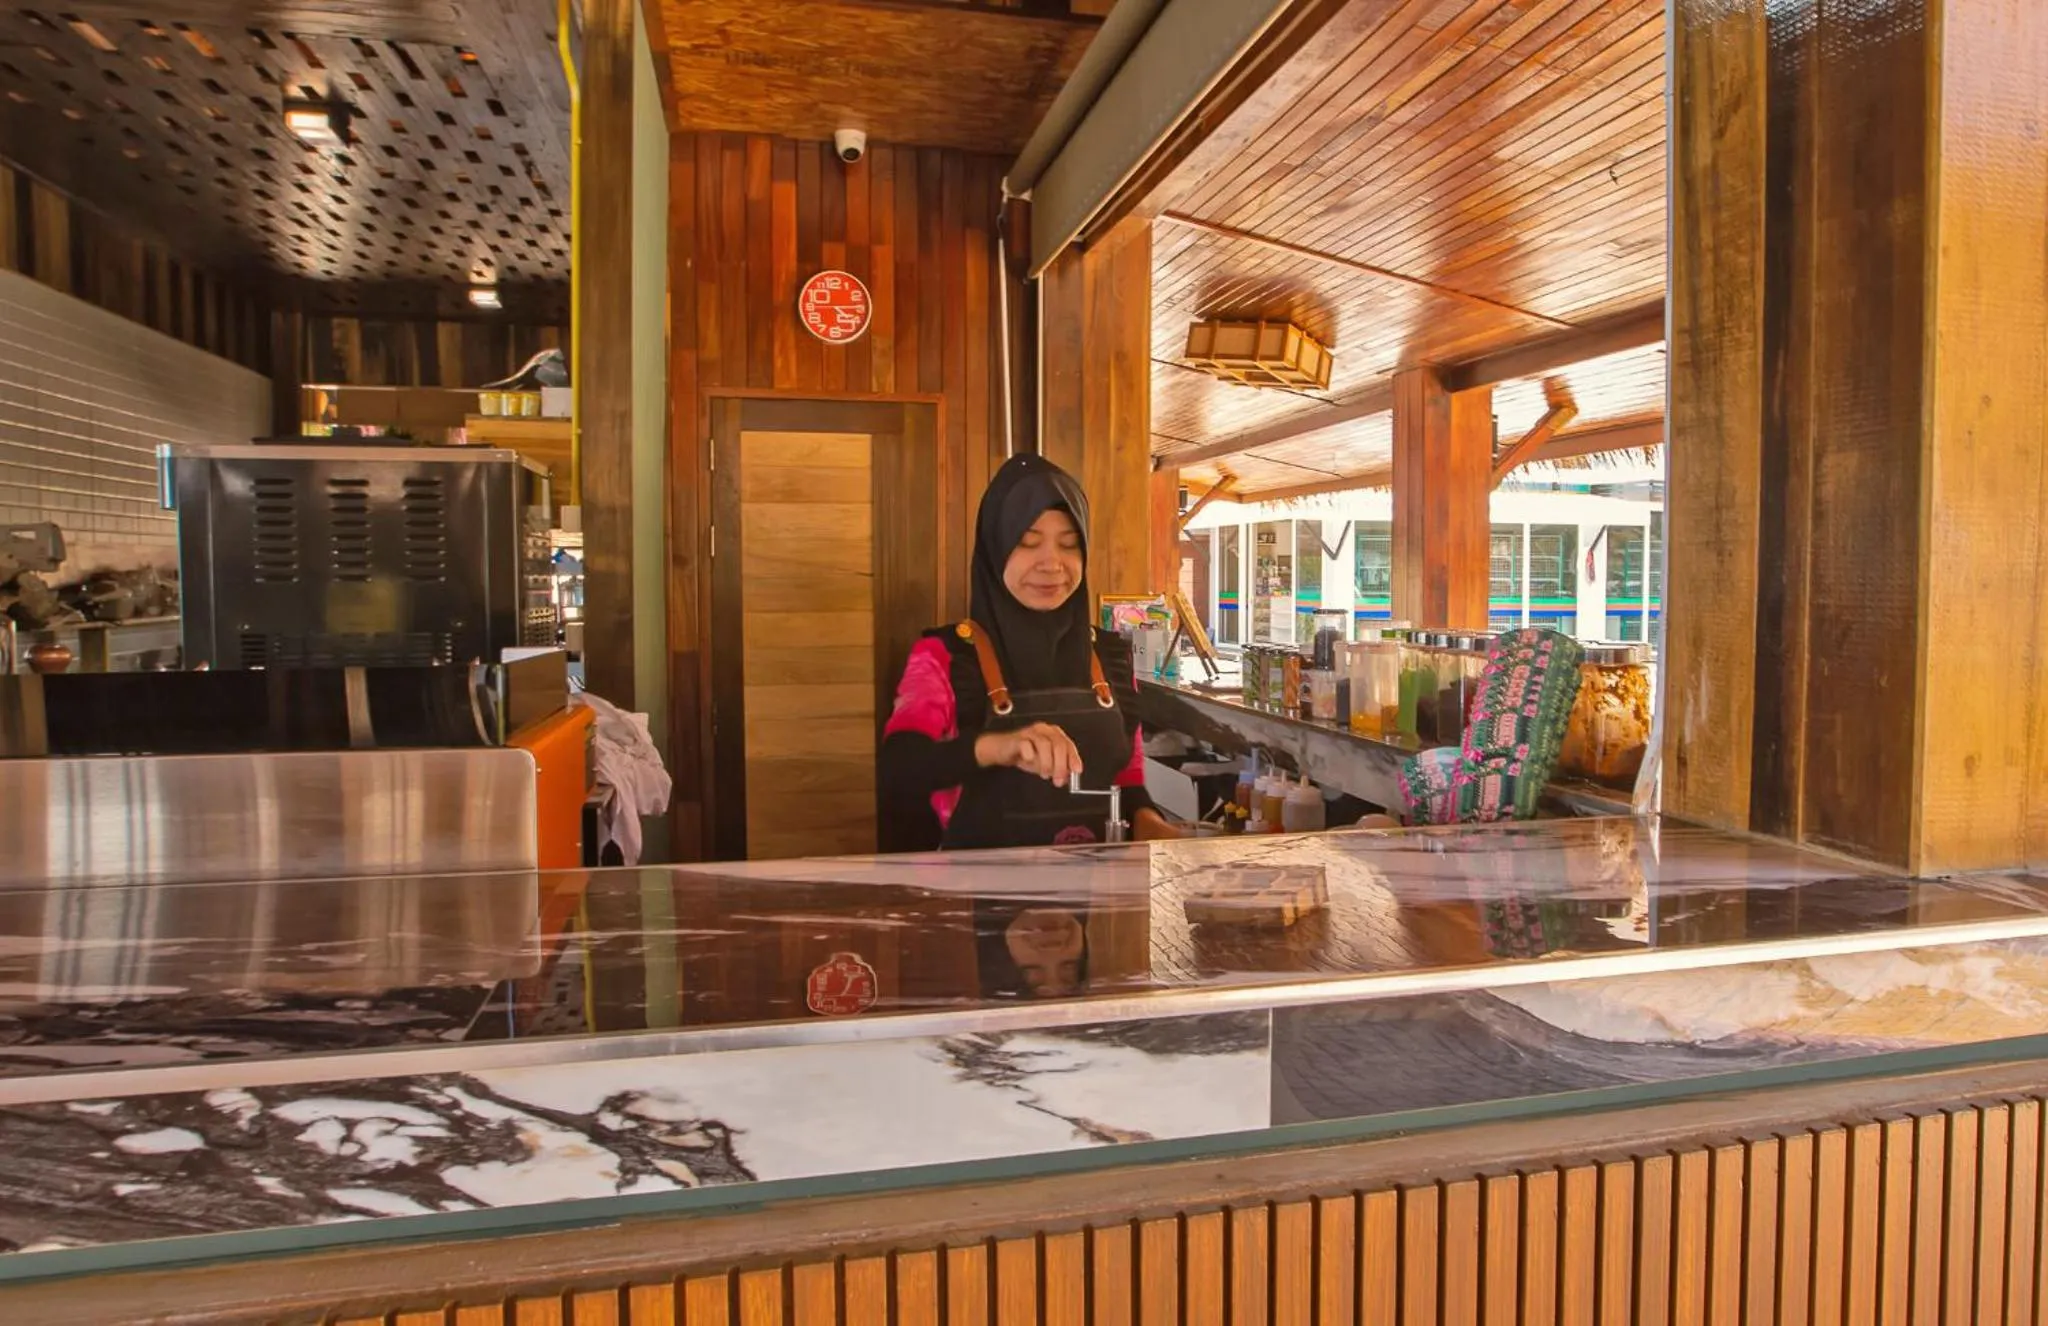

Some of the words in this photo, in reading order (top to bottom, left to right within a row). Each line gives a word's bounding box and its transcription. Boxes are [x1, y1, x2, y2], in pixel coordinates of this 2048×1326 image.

[824, 276, 841, 289] 12
[844, 282, 849, 290] 1
[808, 289, 830, 304] 10
[850, 290, 862, 301] 2
[808, 312, 821, 324] 8
[817, 323, 827, 333] 7
